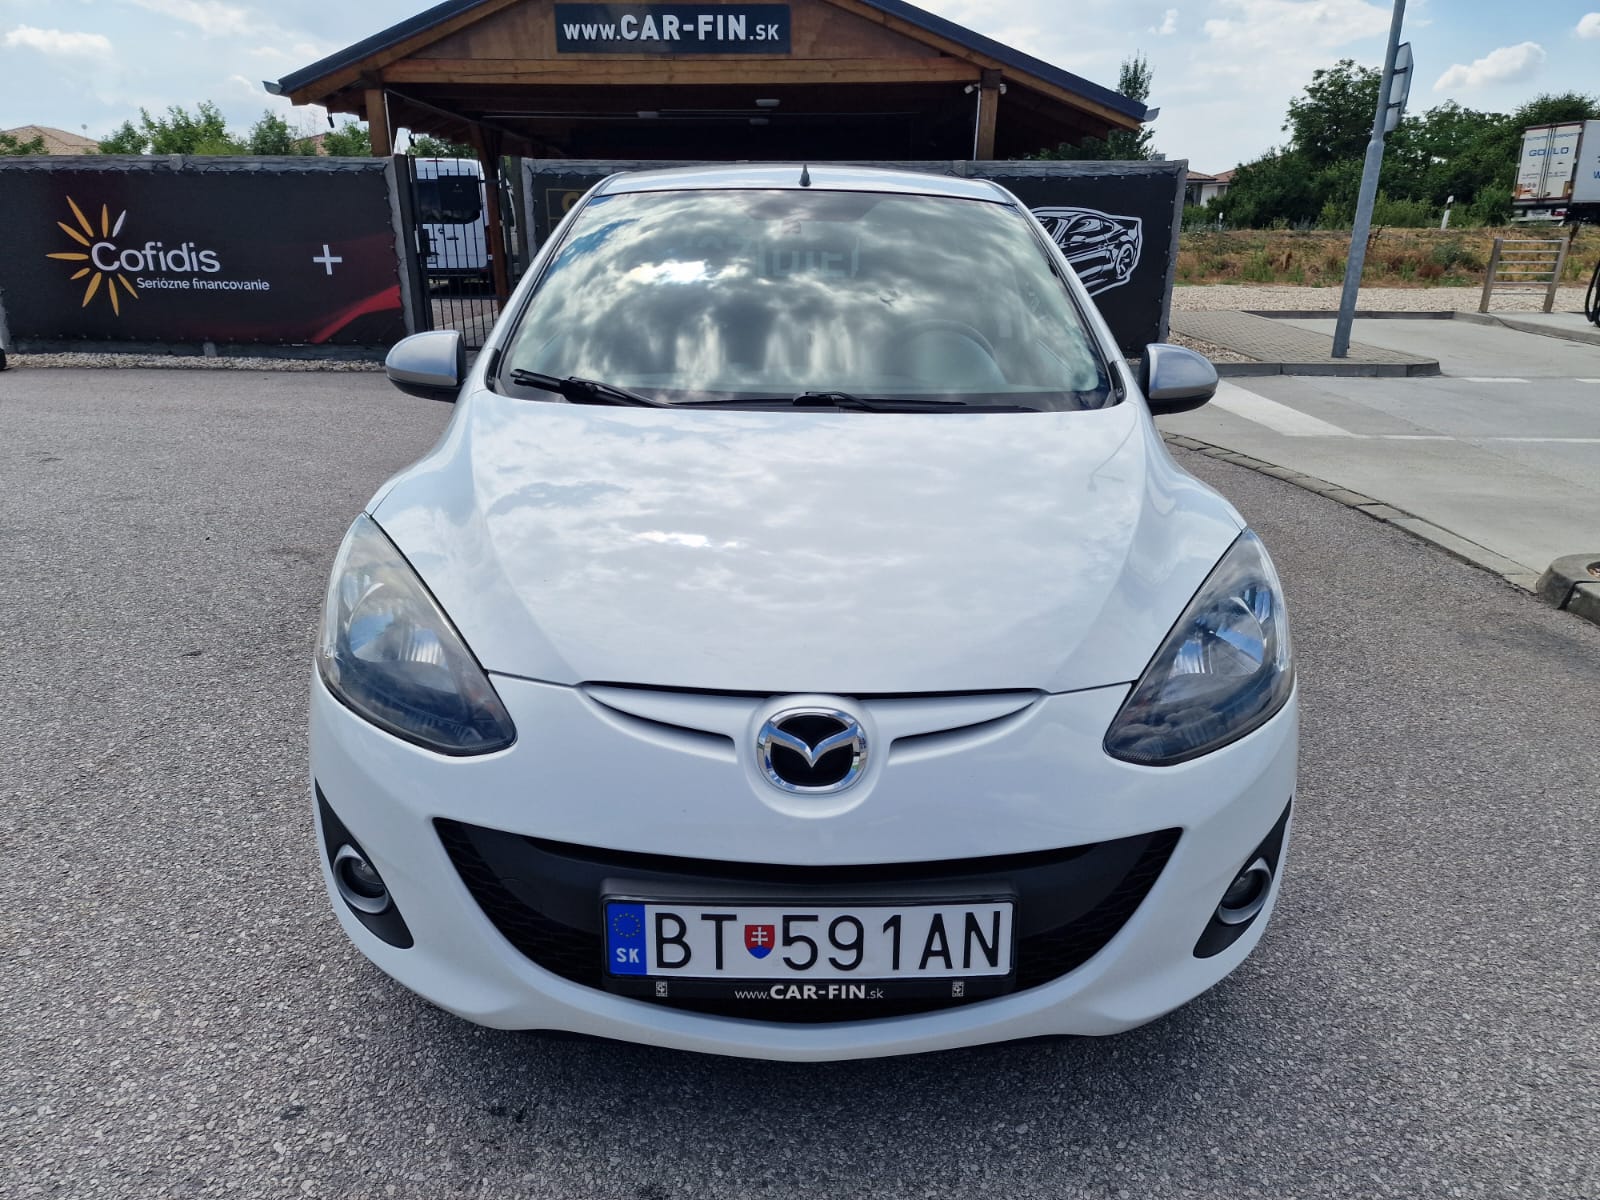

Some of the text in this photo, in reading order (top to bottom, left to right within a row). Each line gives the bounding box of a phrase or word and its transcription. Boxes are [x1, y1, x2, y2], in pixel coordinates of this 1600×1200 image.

[91, 242, 221, 272] Cofidis
[136, 276, 271, 291] Seriózne financovanie
[655, 910, 1001, 972] BT 591AN
[616, 947, 641, 964] SK
[734, 984, 885, 1000] www.CAR-FIN.sk
